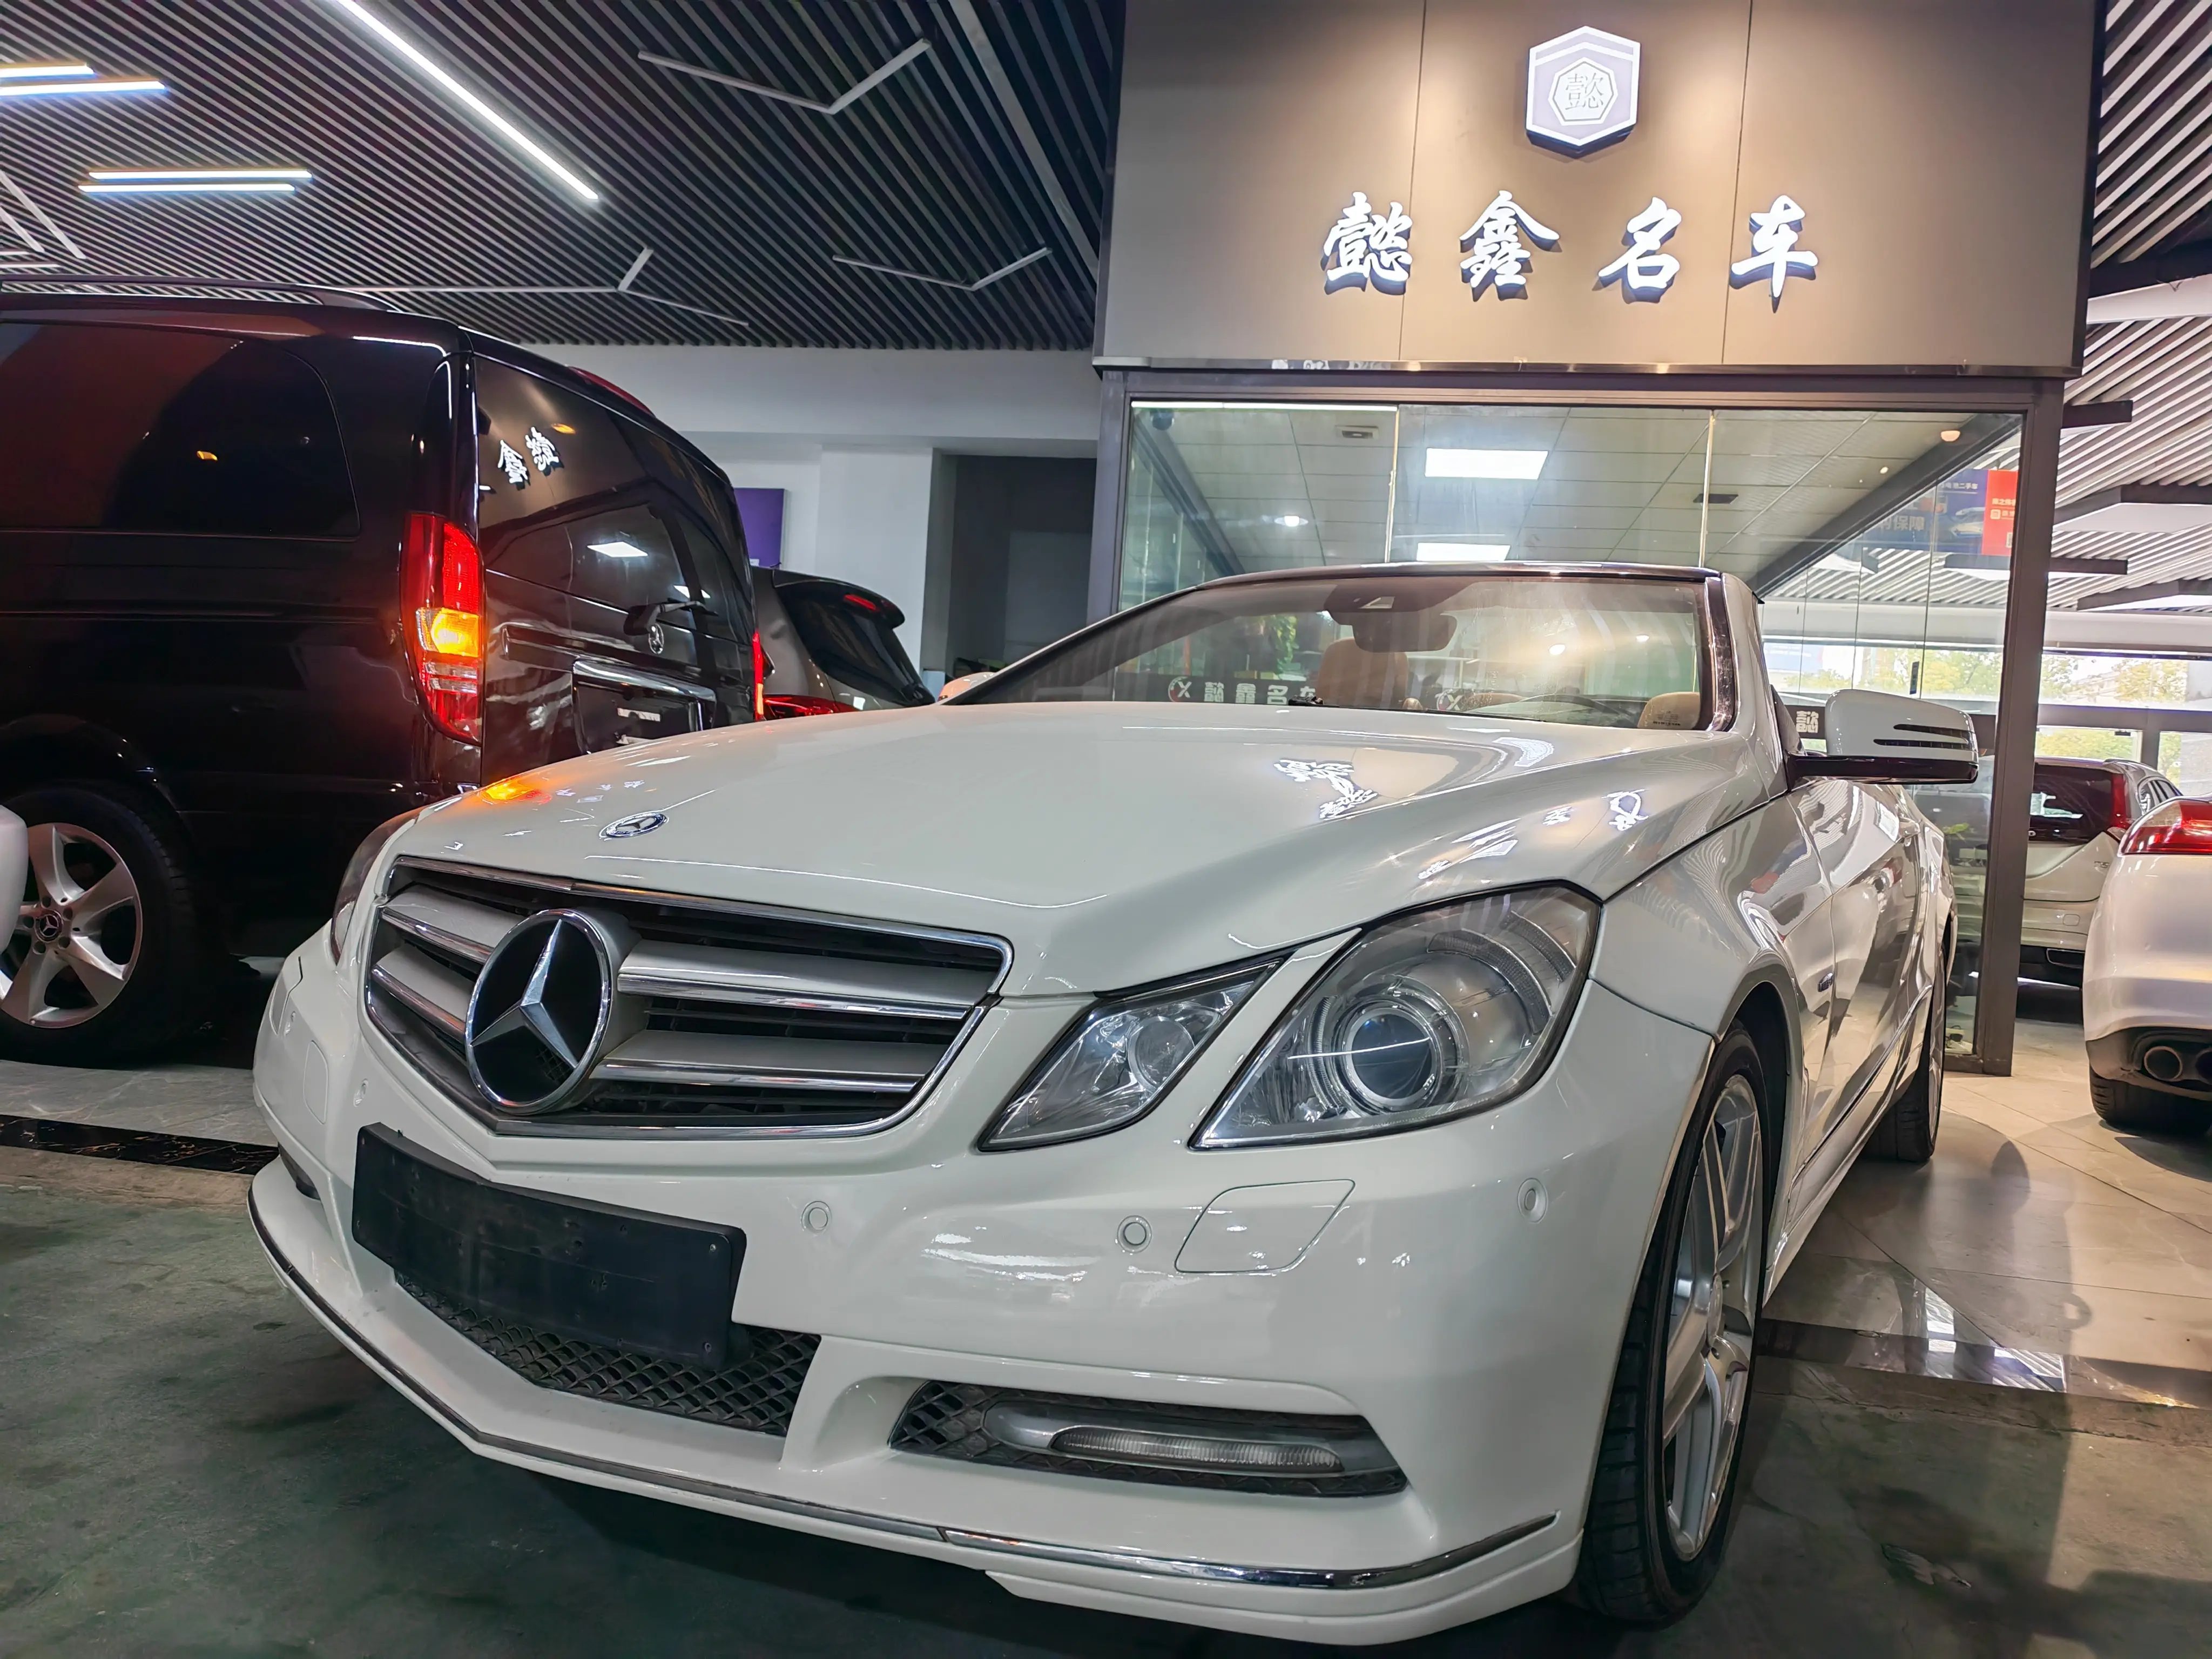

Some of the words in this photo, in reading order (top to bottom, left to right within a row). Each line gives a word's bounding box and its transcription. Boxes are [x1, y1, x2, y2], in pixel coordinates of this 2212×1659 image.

[1565, 72, 1604, 110] 懿
[1323, 190, 1818, 300] 懿鑫名车
[1796, 711, 1819, 733] 懿
